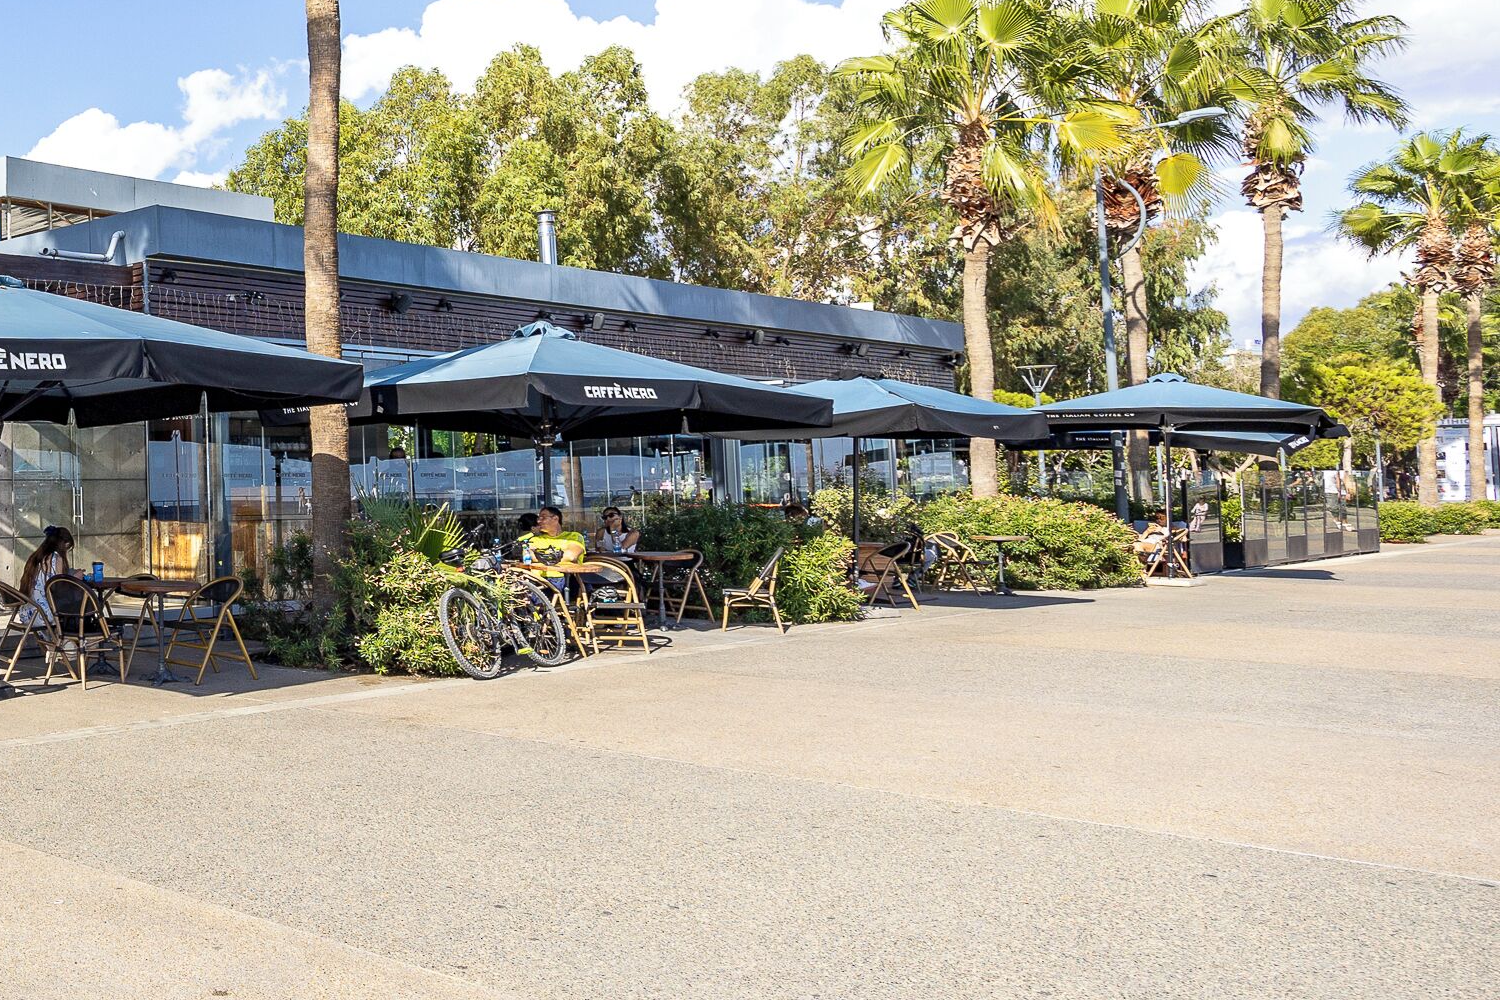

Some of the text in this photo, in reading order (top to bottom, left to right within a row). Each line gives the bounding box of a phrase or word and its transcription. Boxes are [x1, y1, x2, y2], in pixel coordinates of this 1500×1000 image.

[10, 352, 67, 371] NERO
[583, 382, 658, 400] CAFFÈ NERO
[283, 407, 296, 415] THE
